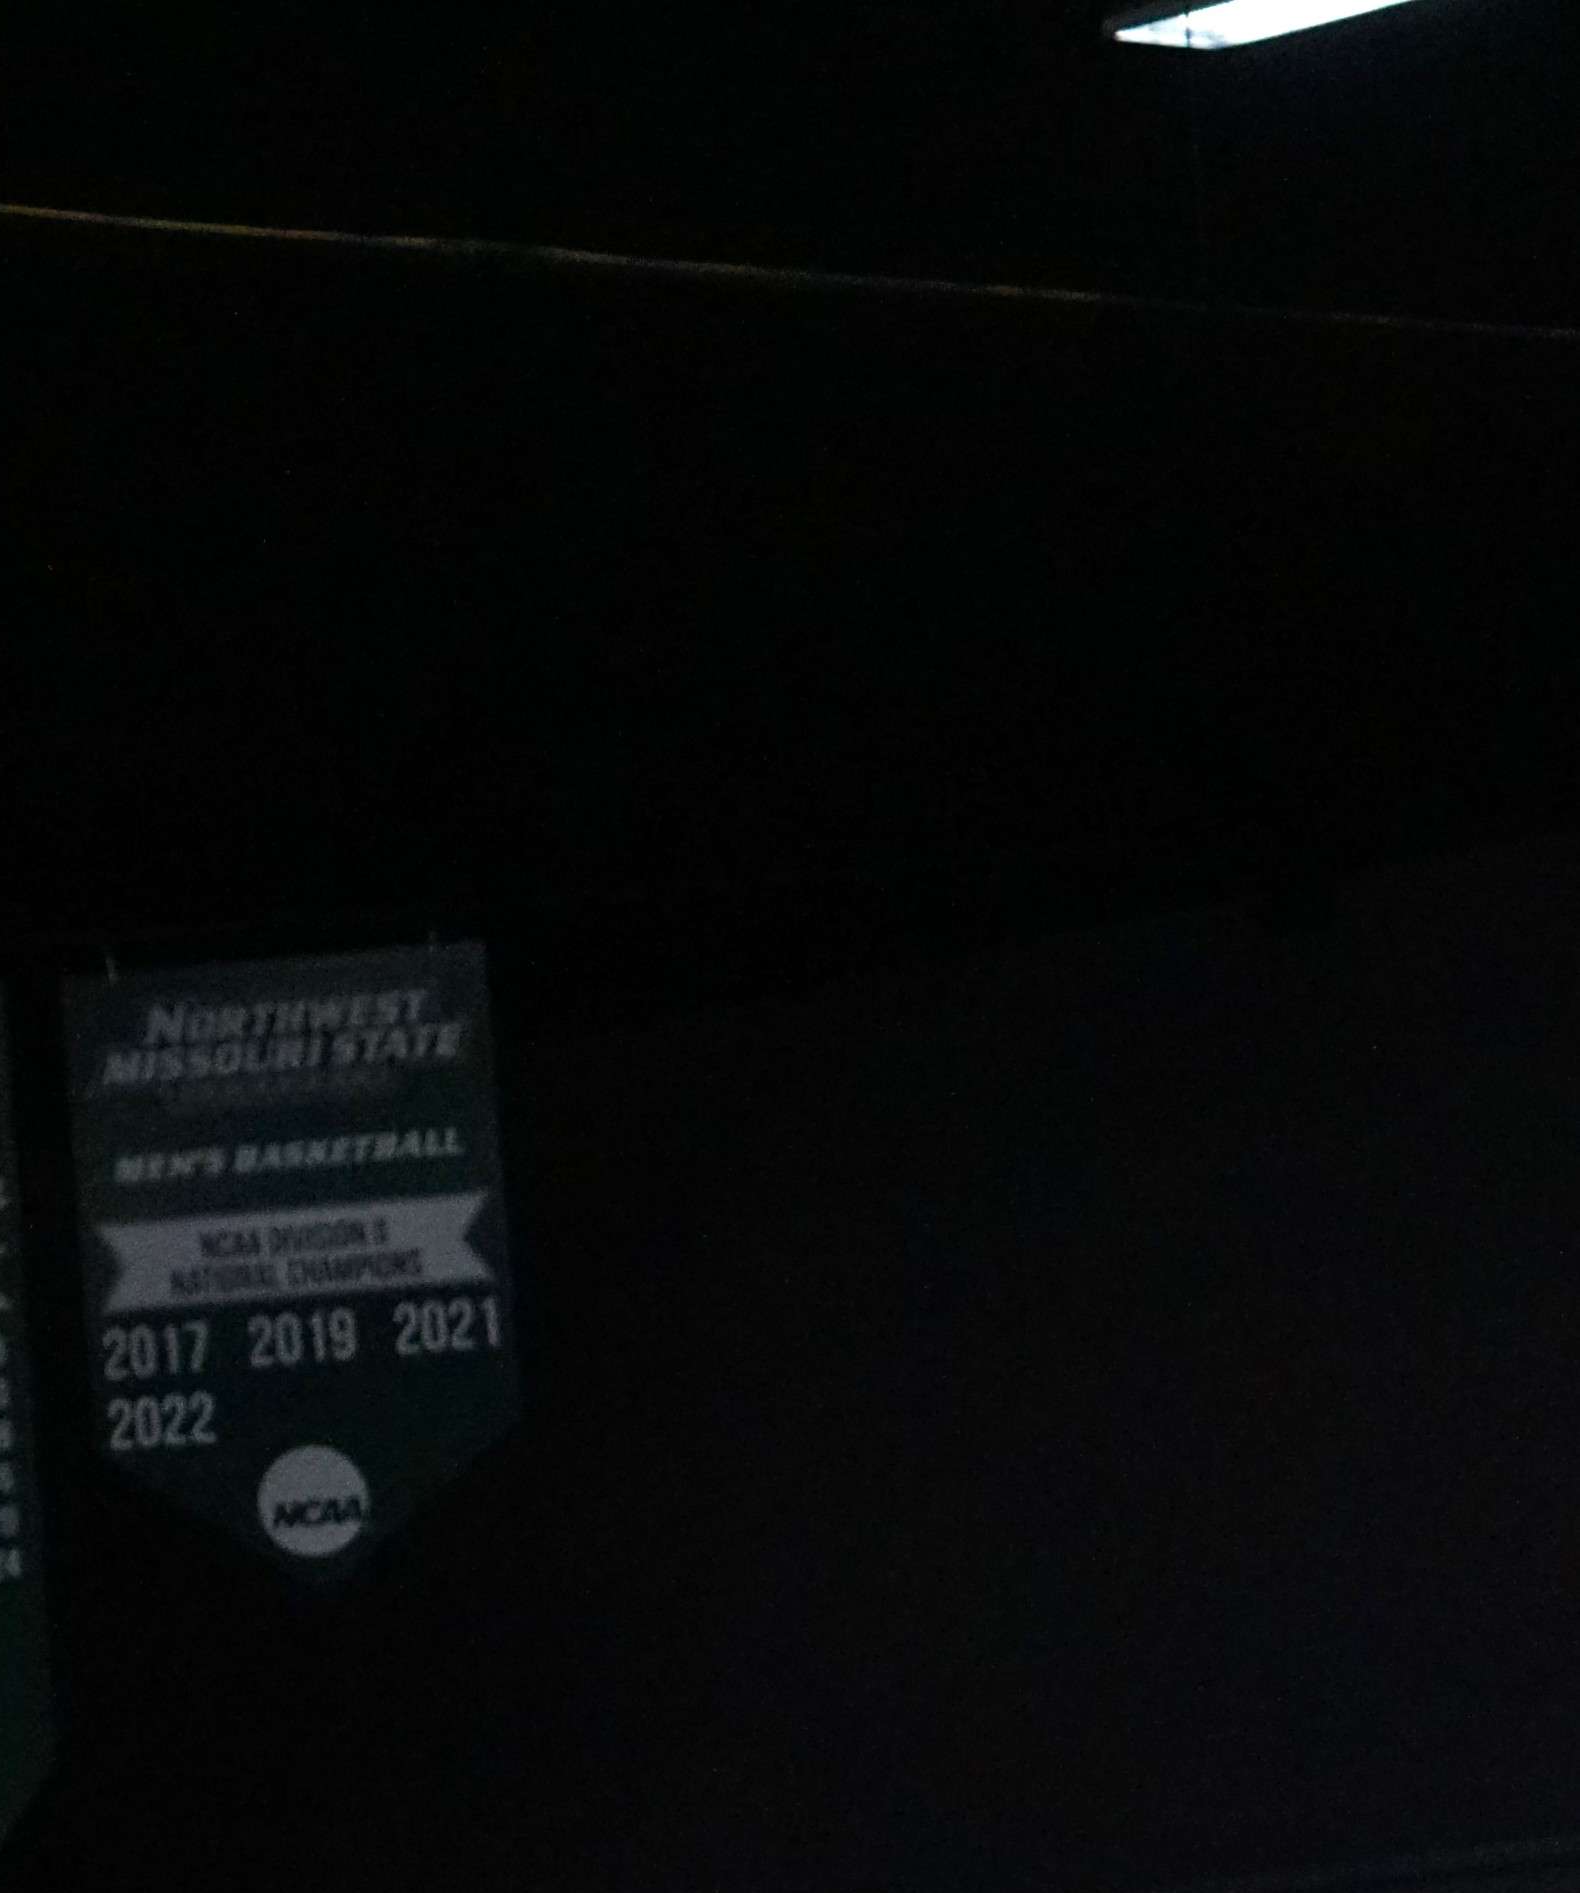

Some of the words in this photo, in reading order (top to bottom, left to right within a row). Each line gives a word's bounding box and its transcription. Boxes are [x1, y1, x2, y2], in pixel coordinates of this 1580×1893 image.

[102, 1318, 209, 1381] 2017
[246, 1307, 357, 1369] 2019
[392, 1295, 502, 1356] 2021
[107, 1390, 217, 1451] 2022
[272, 1498, 363, 1527] NCAA
